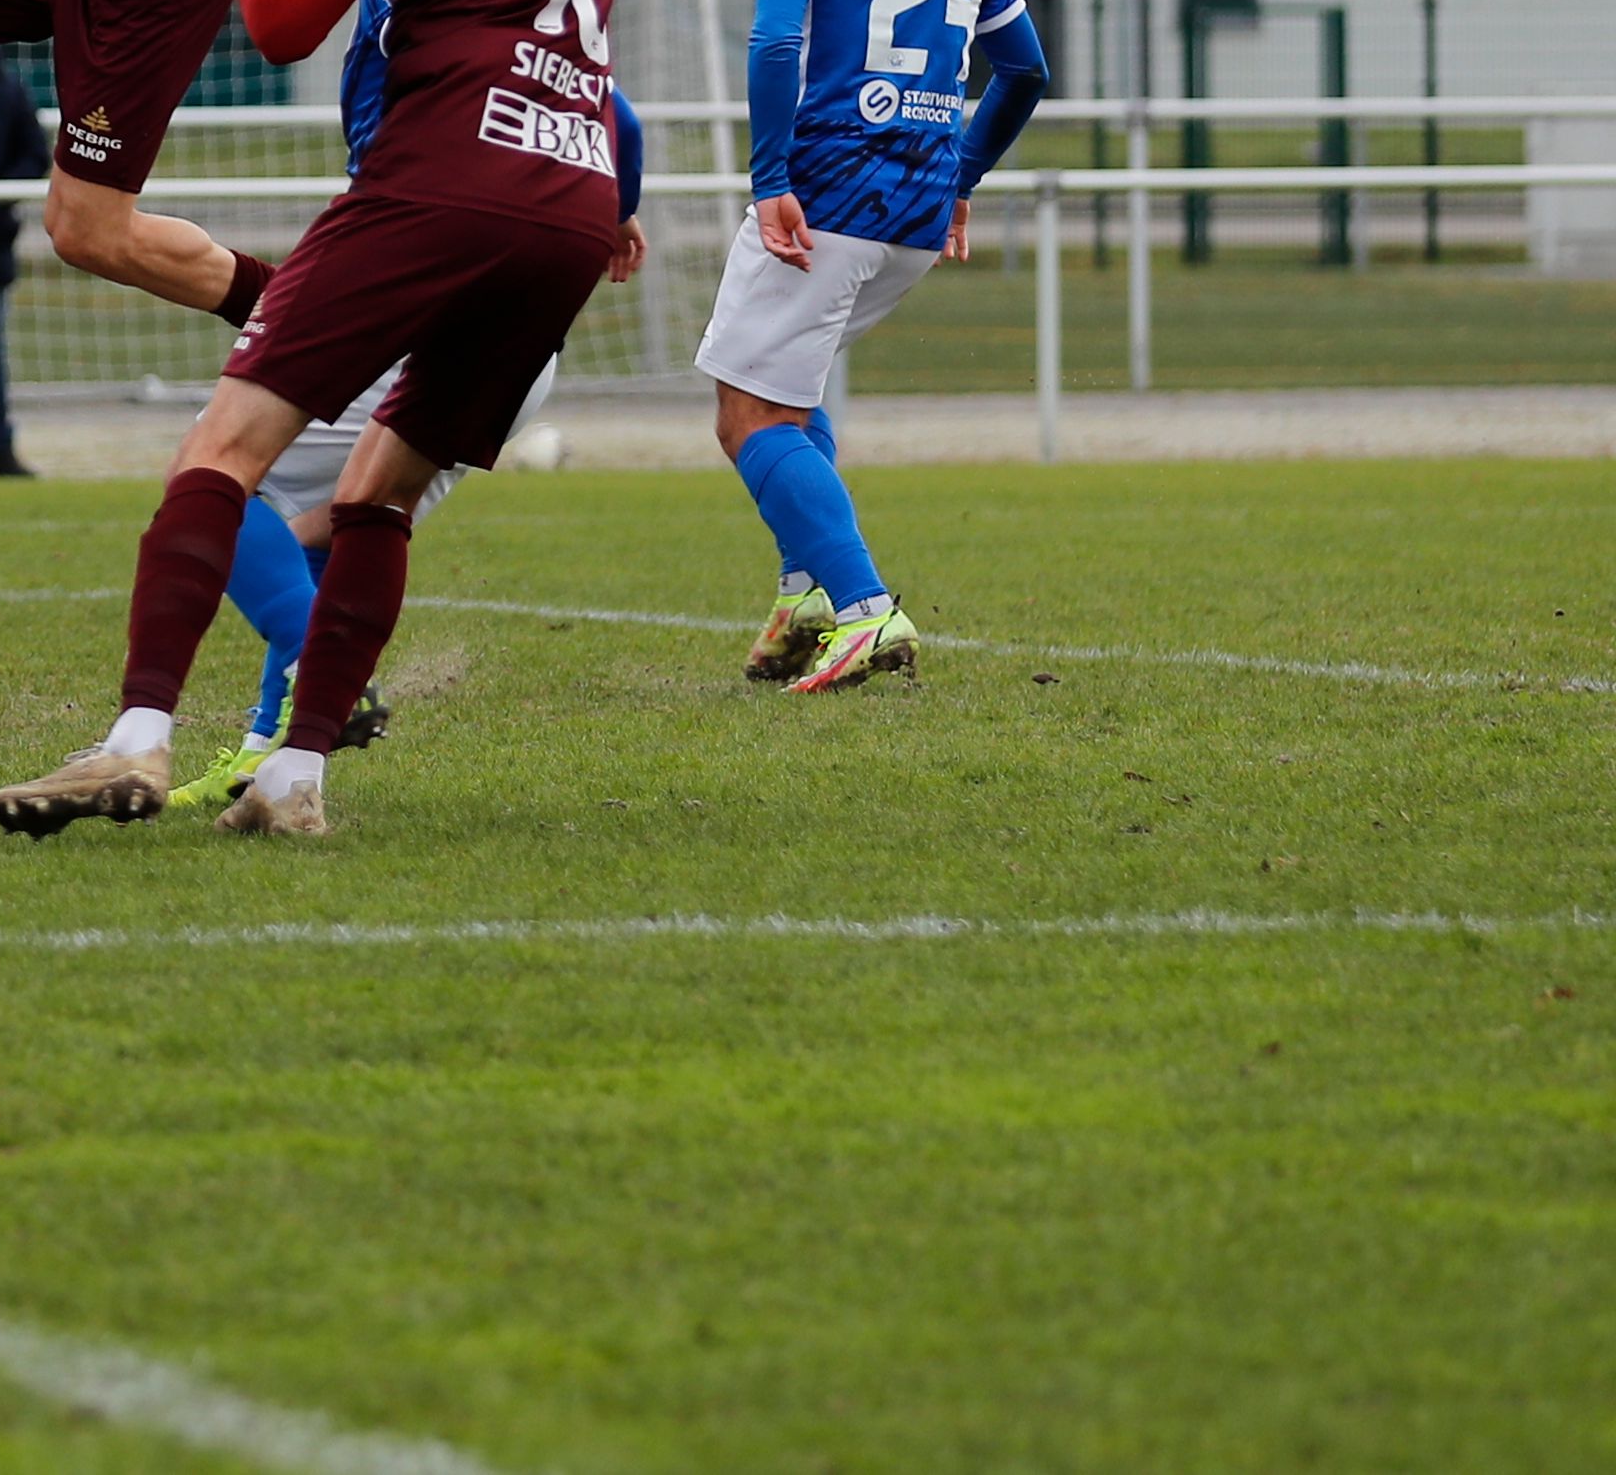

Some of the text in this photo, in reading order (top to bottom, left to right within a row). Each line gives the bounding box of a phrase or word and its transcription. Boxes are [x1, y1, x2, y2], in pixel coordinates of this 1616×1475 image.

[902, 89, 964, 111] STADTWER
[901, 104, 952, 124] ROSTOCK
[66, 122, 123, 150] DEBAG
[69, 141, 107, 162] JAKO
